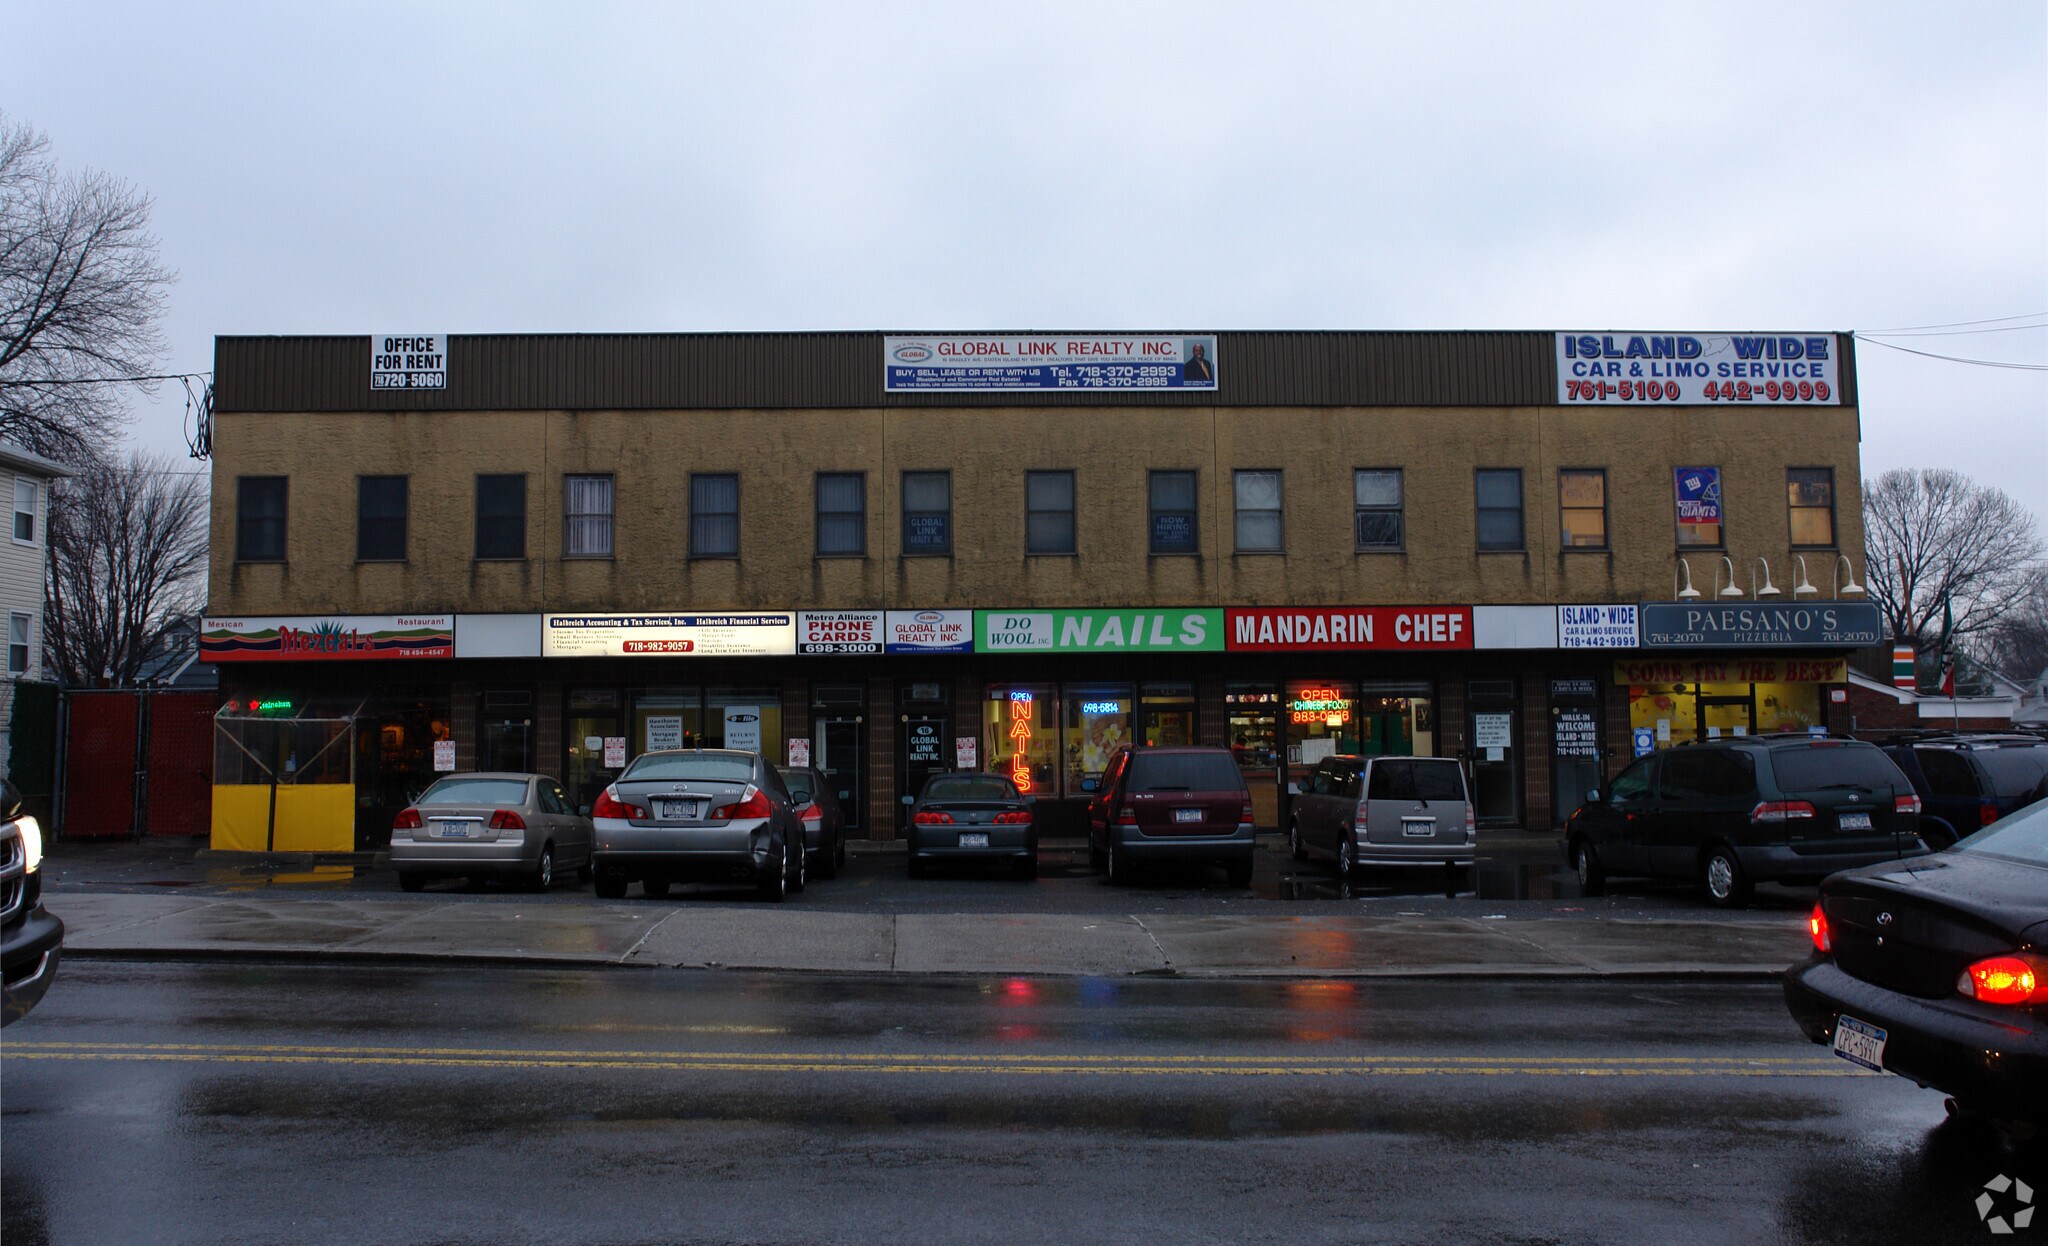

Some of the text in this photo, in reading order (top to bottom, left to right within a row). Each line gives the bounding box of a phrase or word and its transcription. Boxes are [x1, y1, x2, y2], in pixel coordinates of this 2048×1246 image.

[384, 337, 434, 352] OFFICE
[938, 342, 1177, 356] GLOBAL LINK REALTY INC.
[1564, 336, 1829, 359] ISLAND WIDE
[375, 354, 442, 369] FOR RENT
[896, 369, 915, 378] BUY,
[917, 369, 939, 378] SELL,
[1050, 366, 1177, 377] Tel. 718-370-2993
[1572, 361, 1824, 377] CAR & LIMO SERVICE
[384, 373, 442, 387] 720-5060
[1058, 378, 1168, 387] Fax 718-370-2995
[1565, 380, 1830, 400] 761-5100 442-9999
[1680, 505, 1717, 517] GIANTS
[911, 518, 944, 527] GLOBAL
[1160, 516, 1185, 524] NOW
[917, 527, 937, 535] LINK
[1156, 523, 1189, 531] HIRING
[397, 618, 445, 626] Restaurant
[553, 618, 585, 627] Halbreich
[586, 619, 622, 628] Accounting
[623, 618, 629, 627] &
[630, 618, 643, 627] Tax
[674, 618, 687, 627] Inc.
[1003, 617, 1032, 630] DO
[1687, 609, 1838, 631] PAESANO'S
[808, 621, 874, 631] PHONE
[895, 624, 963, 633] GLOBAL LINK
[1060, 614, 1207, 646] NAILS
[1235, 614, 1463, 643] MANDARIN CHEF
[1565, 627, 1633, 635] CAR & LIMO SERVICE
[278, 625, 375, 655] Mezcal's
[808, 632, 873, 642] CARDS
[898, 633, 960, 642] REALTY INC.
[991, 632, 1036, 645] WOOL
[1564, 636, 1636, 647] 718-442-9999
[1651, 632, 1704, 643] 761-2070
[1734, 632, 1792, 642] PIZZERIA
[1822, 631, 1874, 642] 761-2070
[629, 642, 688, 651] 718-982-9057
[805, 643, 877, 653] 698-3000
[1691, 661, 1728, 682] TRY
[1737, 661, 1776, 682] THE
[1010, 693, 1033, 701] OPEN
[1301, 689, 1340, 700] OPEN
[1083, 703, 1119, 713] 698-5814
[1294, 700, 1349, 711] CHINESE FOOD
[1561, 713, 1591, 721] WALK-IN
[1556, 721, 1596, 731] WELCOME
[910, 736, 940, 745] GLOBAL
[1010, 701, 1032, 791] NAILS
[909, 753, 930, 761] REALTY
